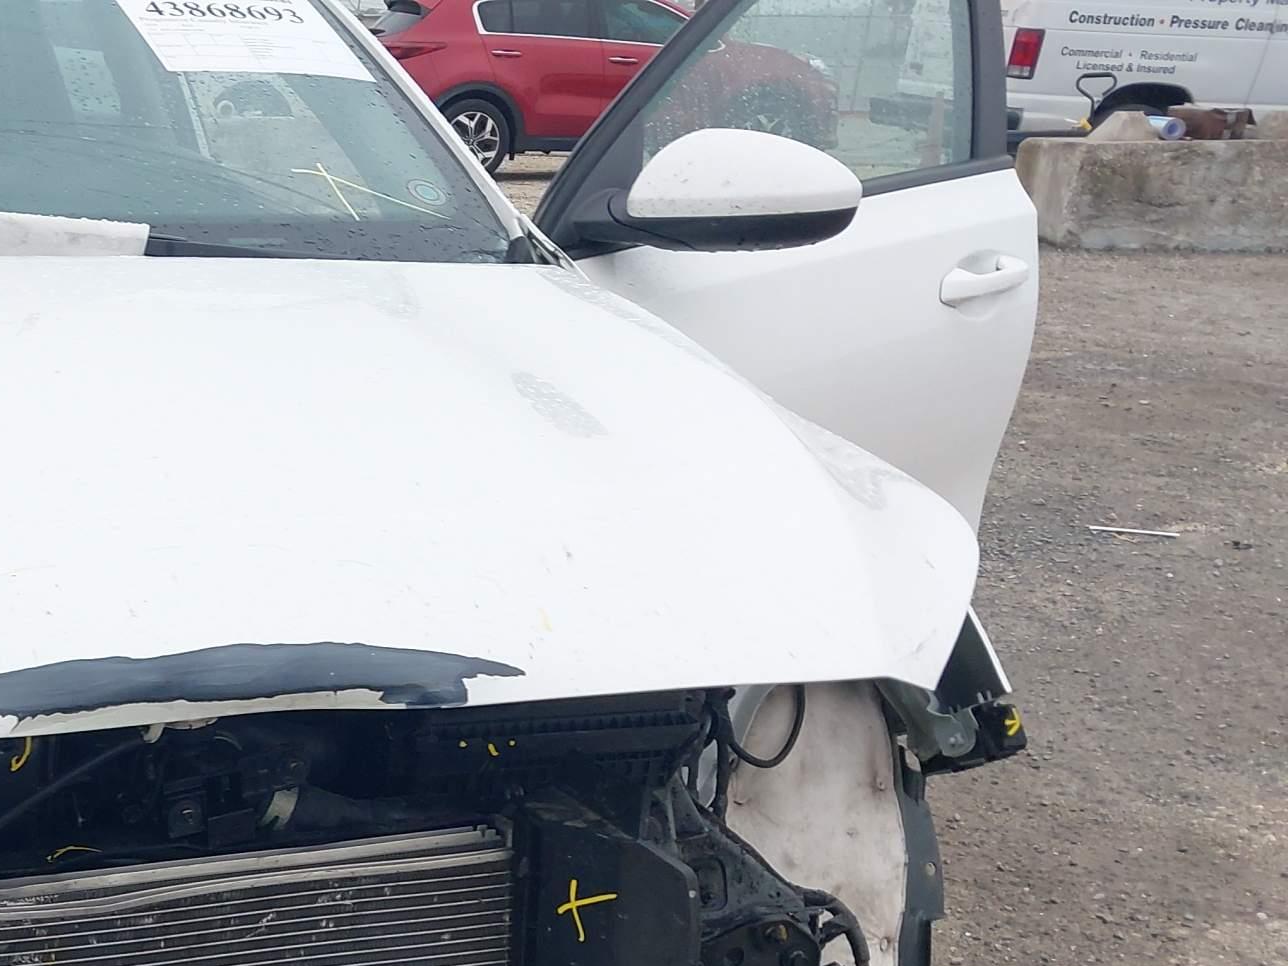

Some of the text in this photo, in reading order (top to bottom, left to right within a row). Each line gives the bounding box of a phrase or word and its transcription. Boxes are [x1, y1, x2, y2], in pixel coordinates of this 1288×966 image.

[145, 0, 304, 24] 43868693
[1069, 10, 1155, 27] Construction
[1170, 15, 1229, 30] Pressure
[1061, 46, 1198, 62] Commercial Residential
[1076, 61, 1176, 75] Licensed & Insured
